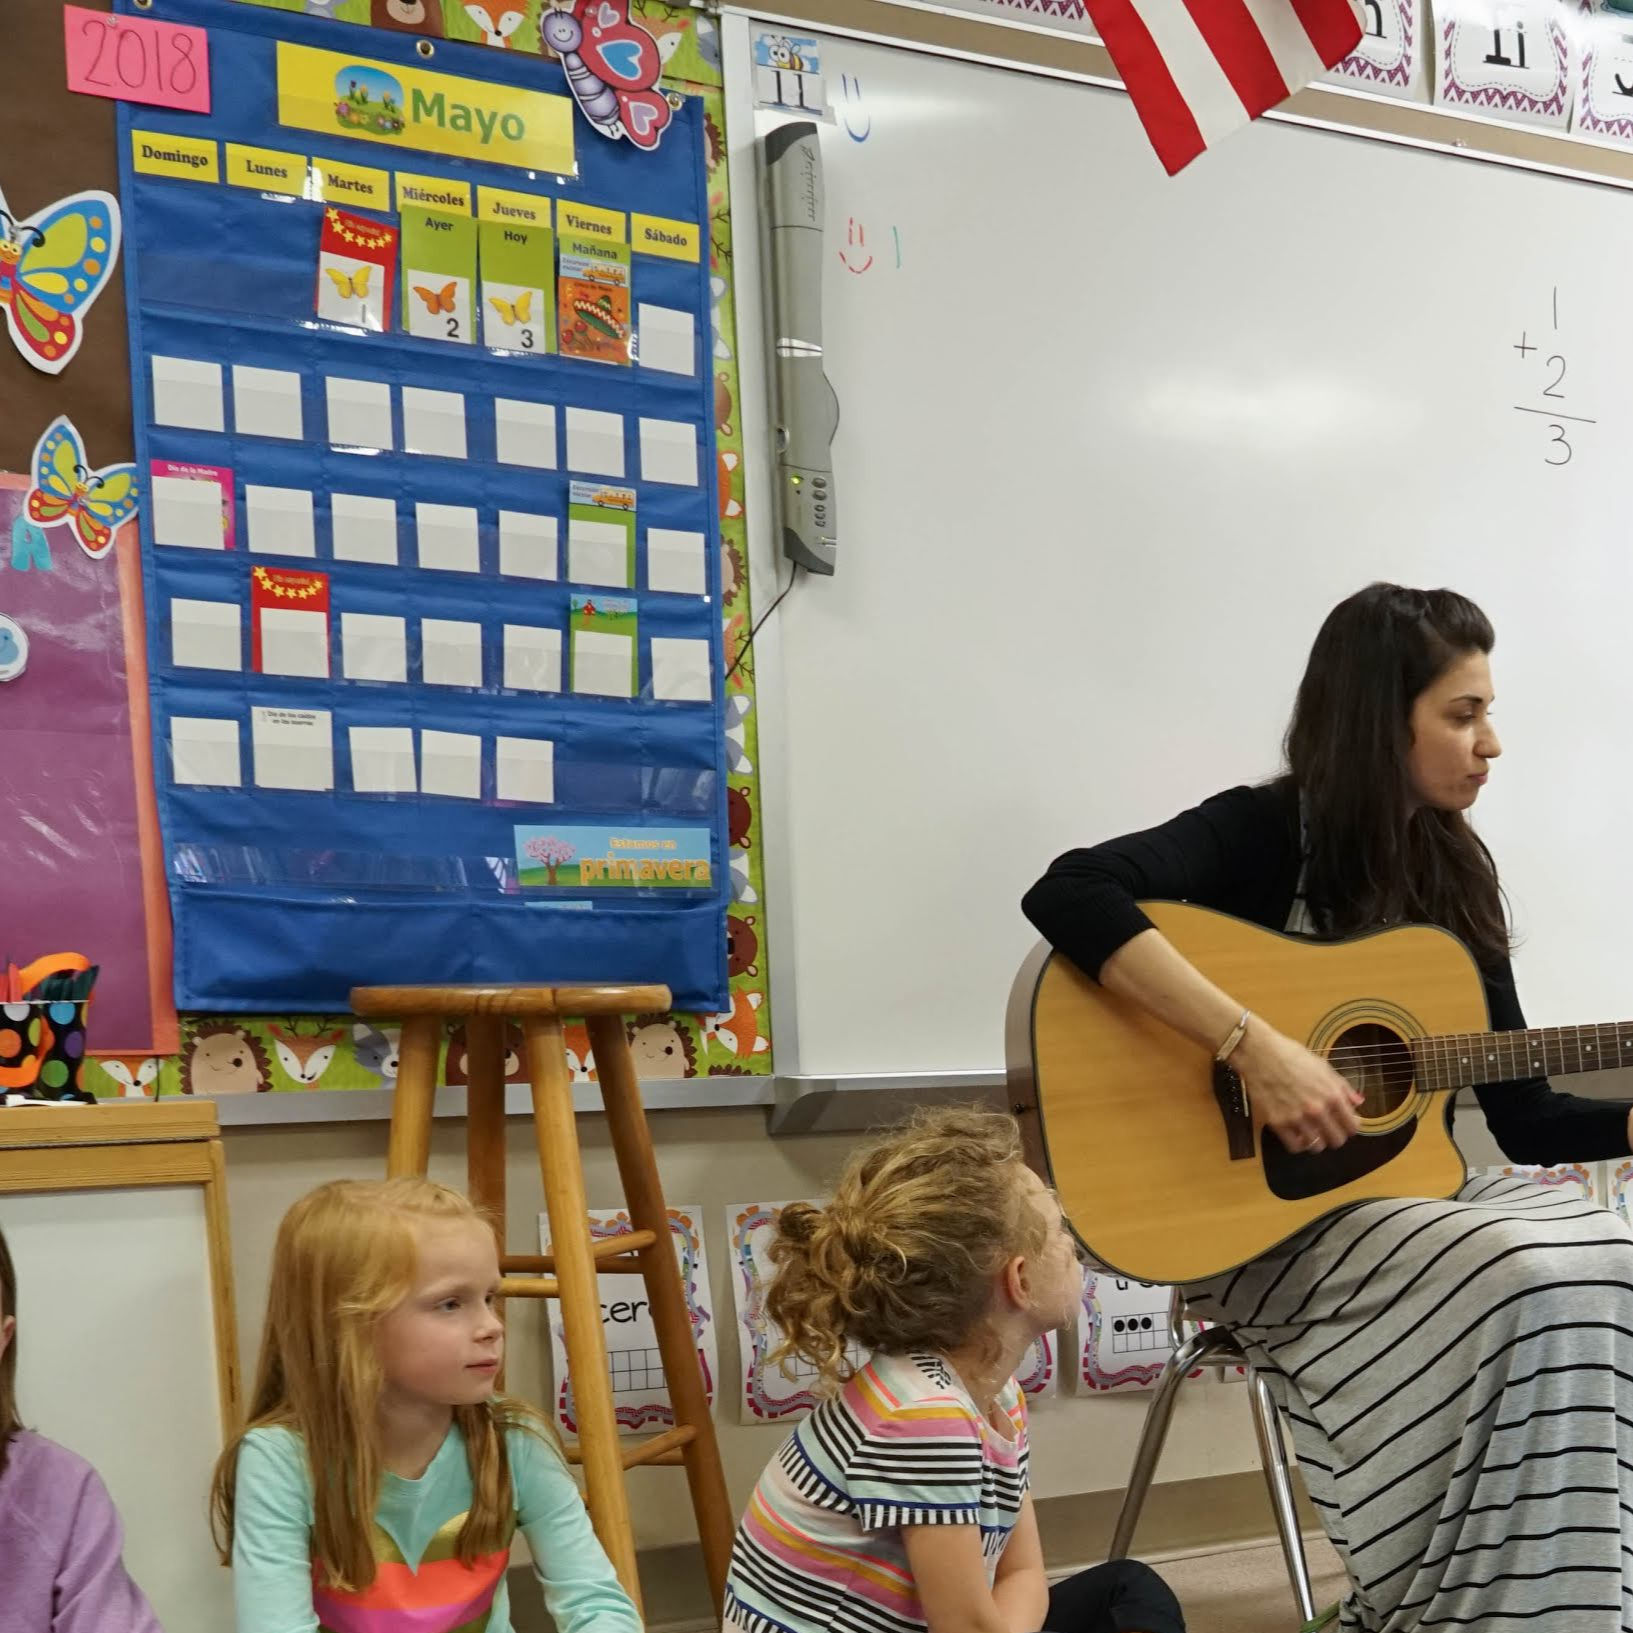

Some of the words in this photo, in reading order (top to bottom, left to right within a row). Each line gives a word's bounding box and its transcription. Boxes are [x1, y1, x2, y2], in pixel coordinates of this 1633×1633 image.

[82, 20, 197, 95] 2018
[411, 87, 526, 145] Mayo
[142, 145, 209, 167] Domingo
[246, 159, 288, 179] Lunes
[327, 173, 374, 195] Martes
[402, 185, 465, 207] Miércoles
[492, 202, 537, 221] Jueves
[566, 214, 613, 236] Viernes
[644, 227, 688, 248] Sábado
[425, 216, 454, 233] Ayer
[503, 229, 529, 245] Hoy
[572, 242, 618, 259] Mañana
[361, 303, 367, 324] 1
[1552, 286, 1559, 330] 1
[446, 318, 461, 339] 2
[520, 329, 535, 350] 3
[1543, 355, 1566, 399] 2
[1544, 424, 1572, 467] 3
[579, 851, 711, 886] primavera
